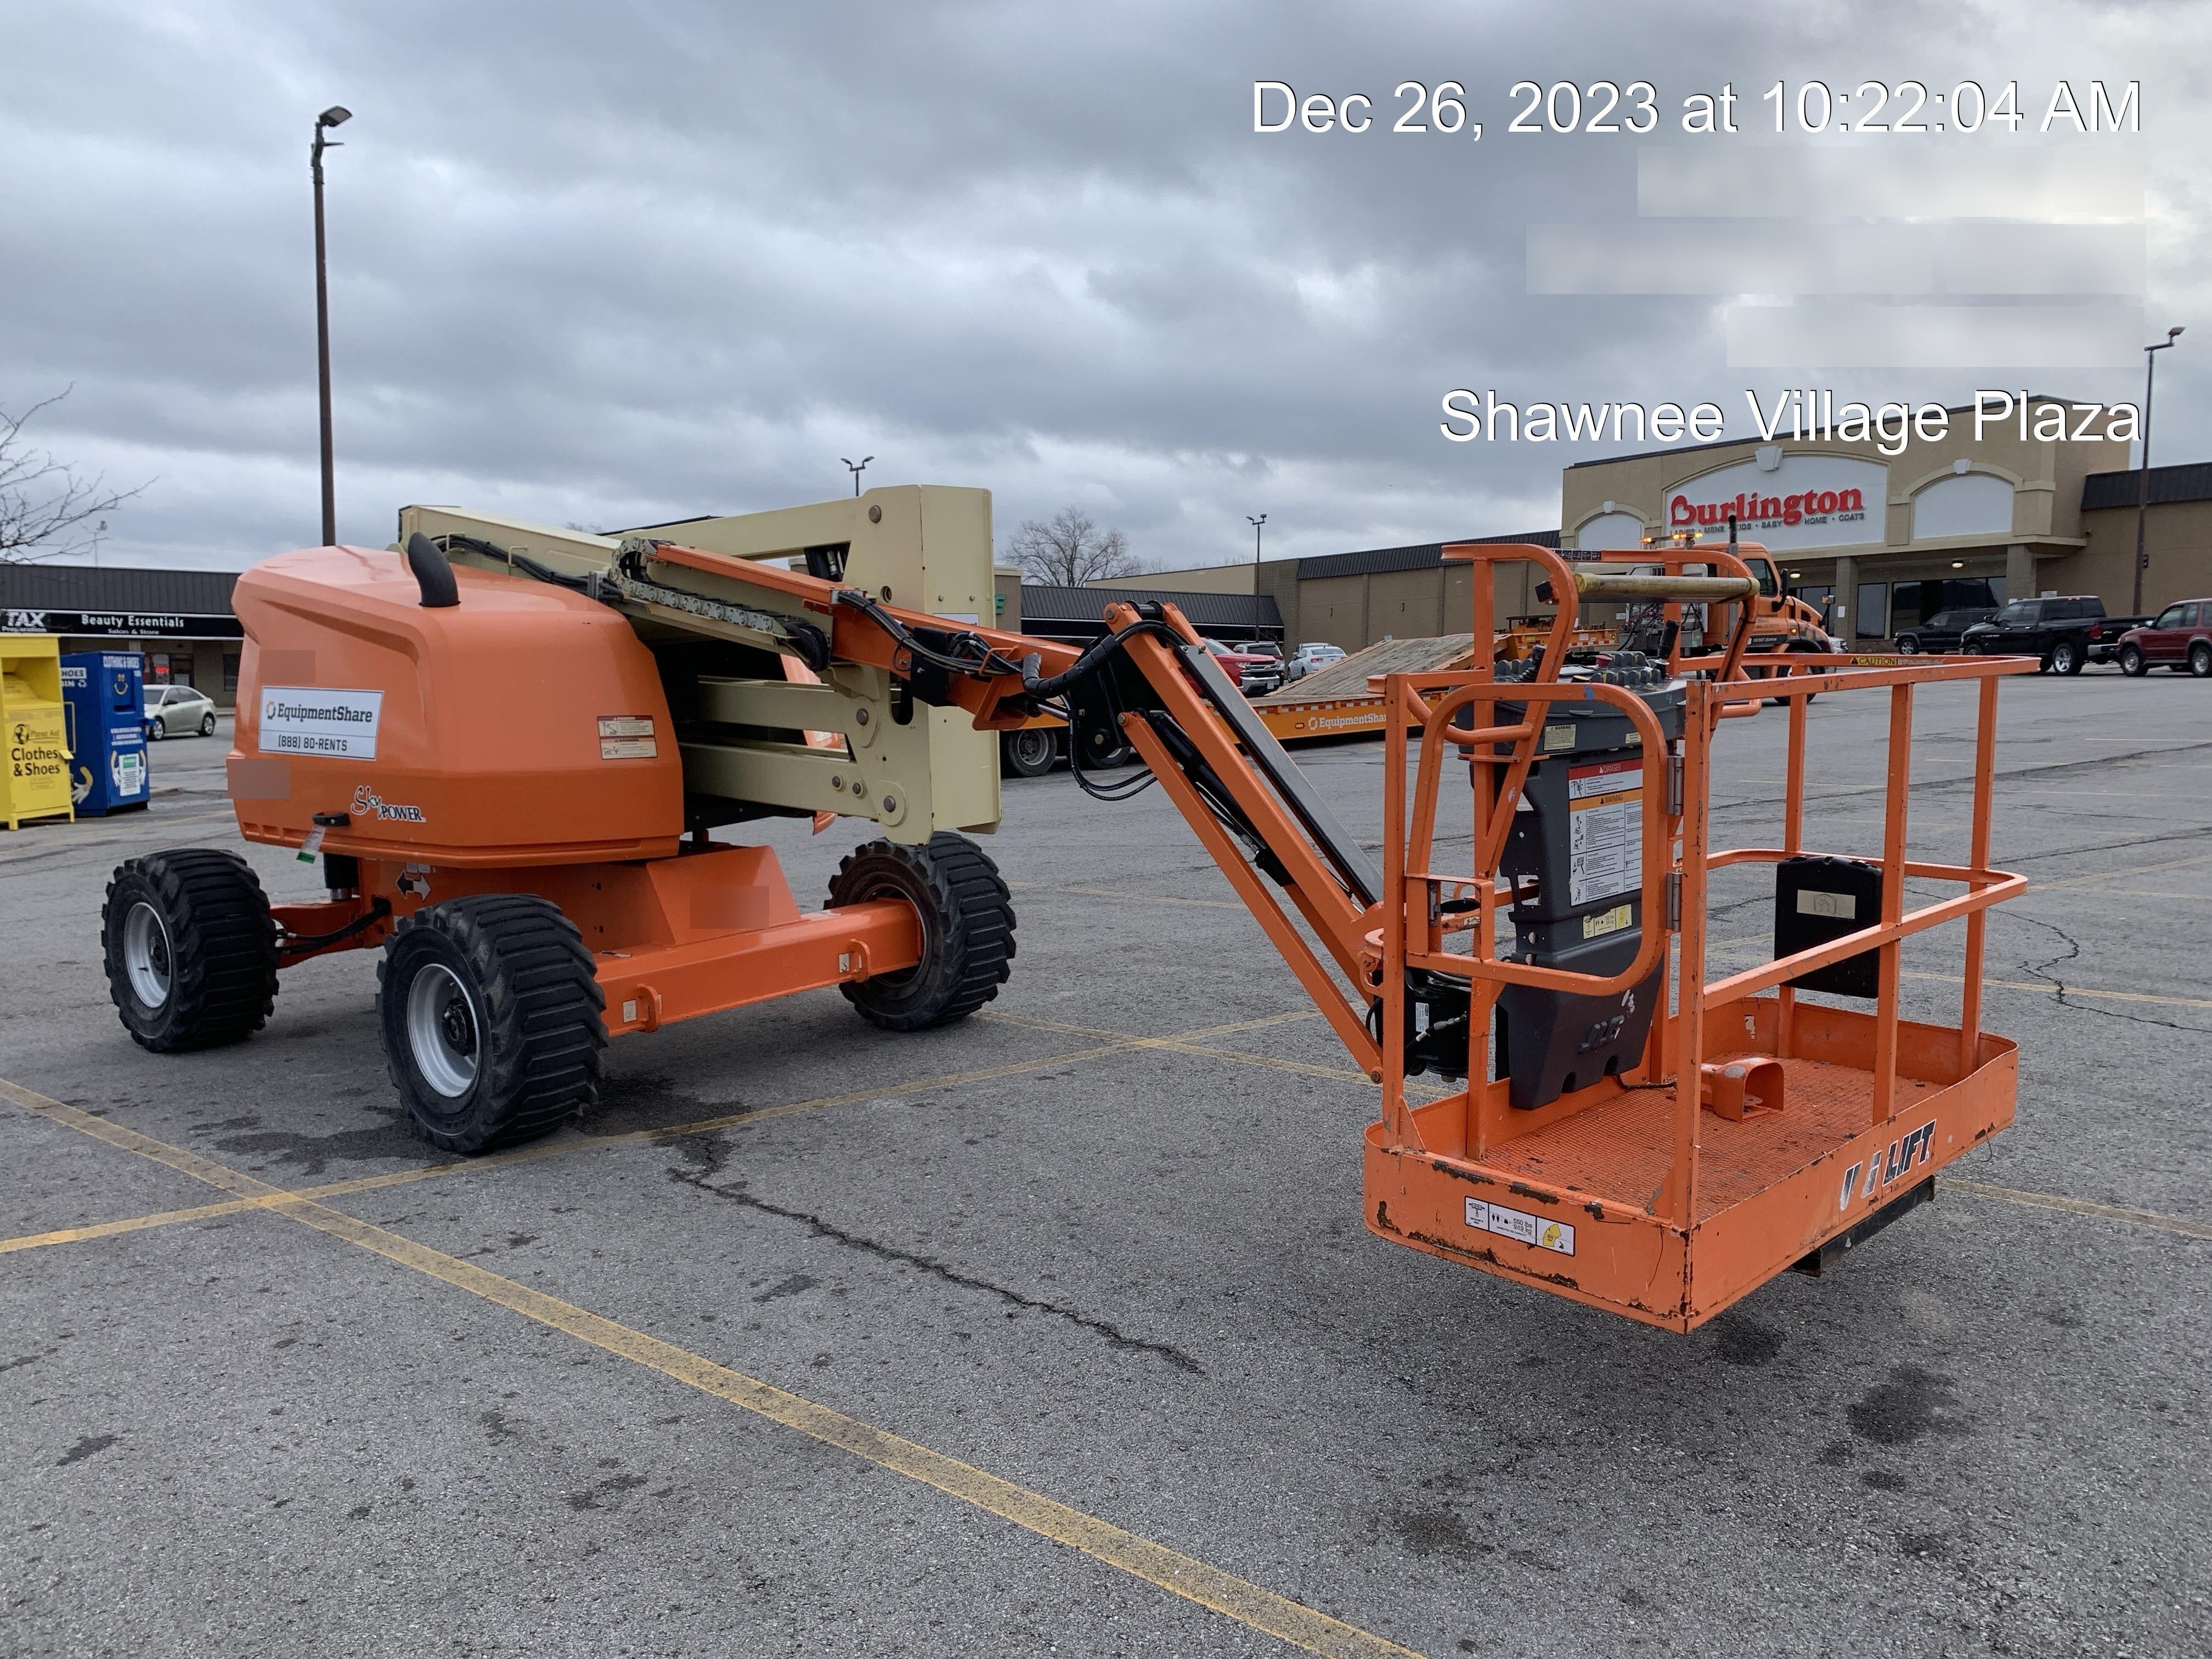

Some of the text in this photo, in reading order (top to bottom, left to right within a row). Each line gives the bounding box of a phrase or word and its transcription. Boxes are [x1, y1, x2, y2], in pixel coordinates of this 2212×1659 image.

[1671, 487, 1864, 526] Burlington
[1704, 525, 1725, 534] MENS
[1761, 520, 1782, 529] BABY
[1804, 516, 1828, 525] HOME
[1838, 512, 1864, 522] COATS
[6, 611, 46, 627] TAX
[81, 614, 184, 628] Beauty Essentials
[1859, 657, 1896, 665] CAUTION
[277, 702, 373, 723] EquipmentShare
[278, 734, 347, 751] (888) 80-RENTS
[11, 746, 59, 761] Clothes
[14, 762, 60, 777] & Shoes
[1602, 763, 1621, 773] DANGER
[1604, 794, 1624, 804] WARNING
[380, 805, 422, 822] POWER
[1882, 1118, 1938, 1188] LIFT
[1513, 1218, 1524, 1227] 550
[1513, 1224, 1532, 1235] 249 kg
